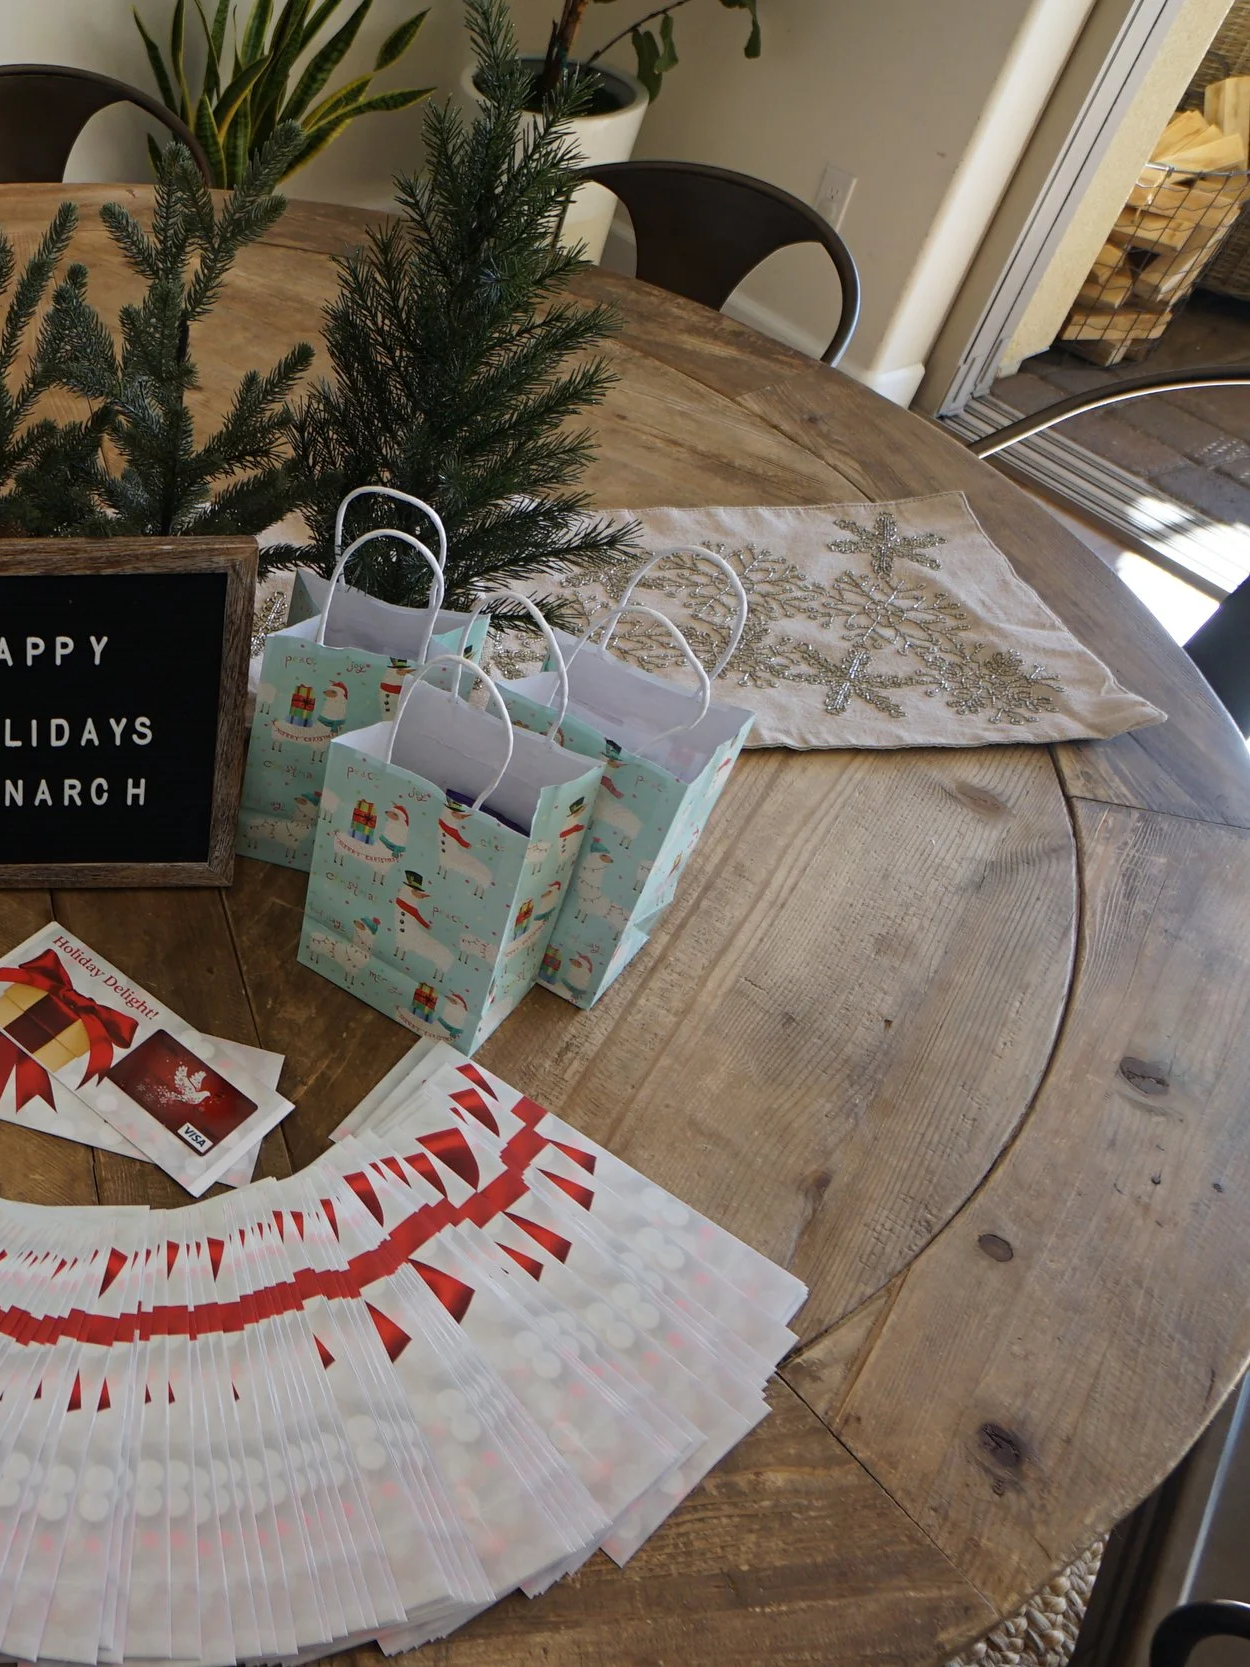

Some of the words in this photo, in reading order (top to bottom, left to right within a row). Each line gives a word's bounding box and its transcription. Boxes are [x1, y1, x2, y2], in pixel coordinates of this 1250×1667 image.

[52, 935, 105, 978] Holiday
[103, 974, 160, 1021] Delight!
[184, 1124, 207, 1148] VISA
